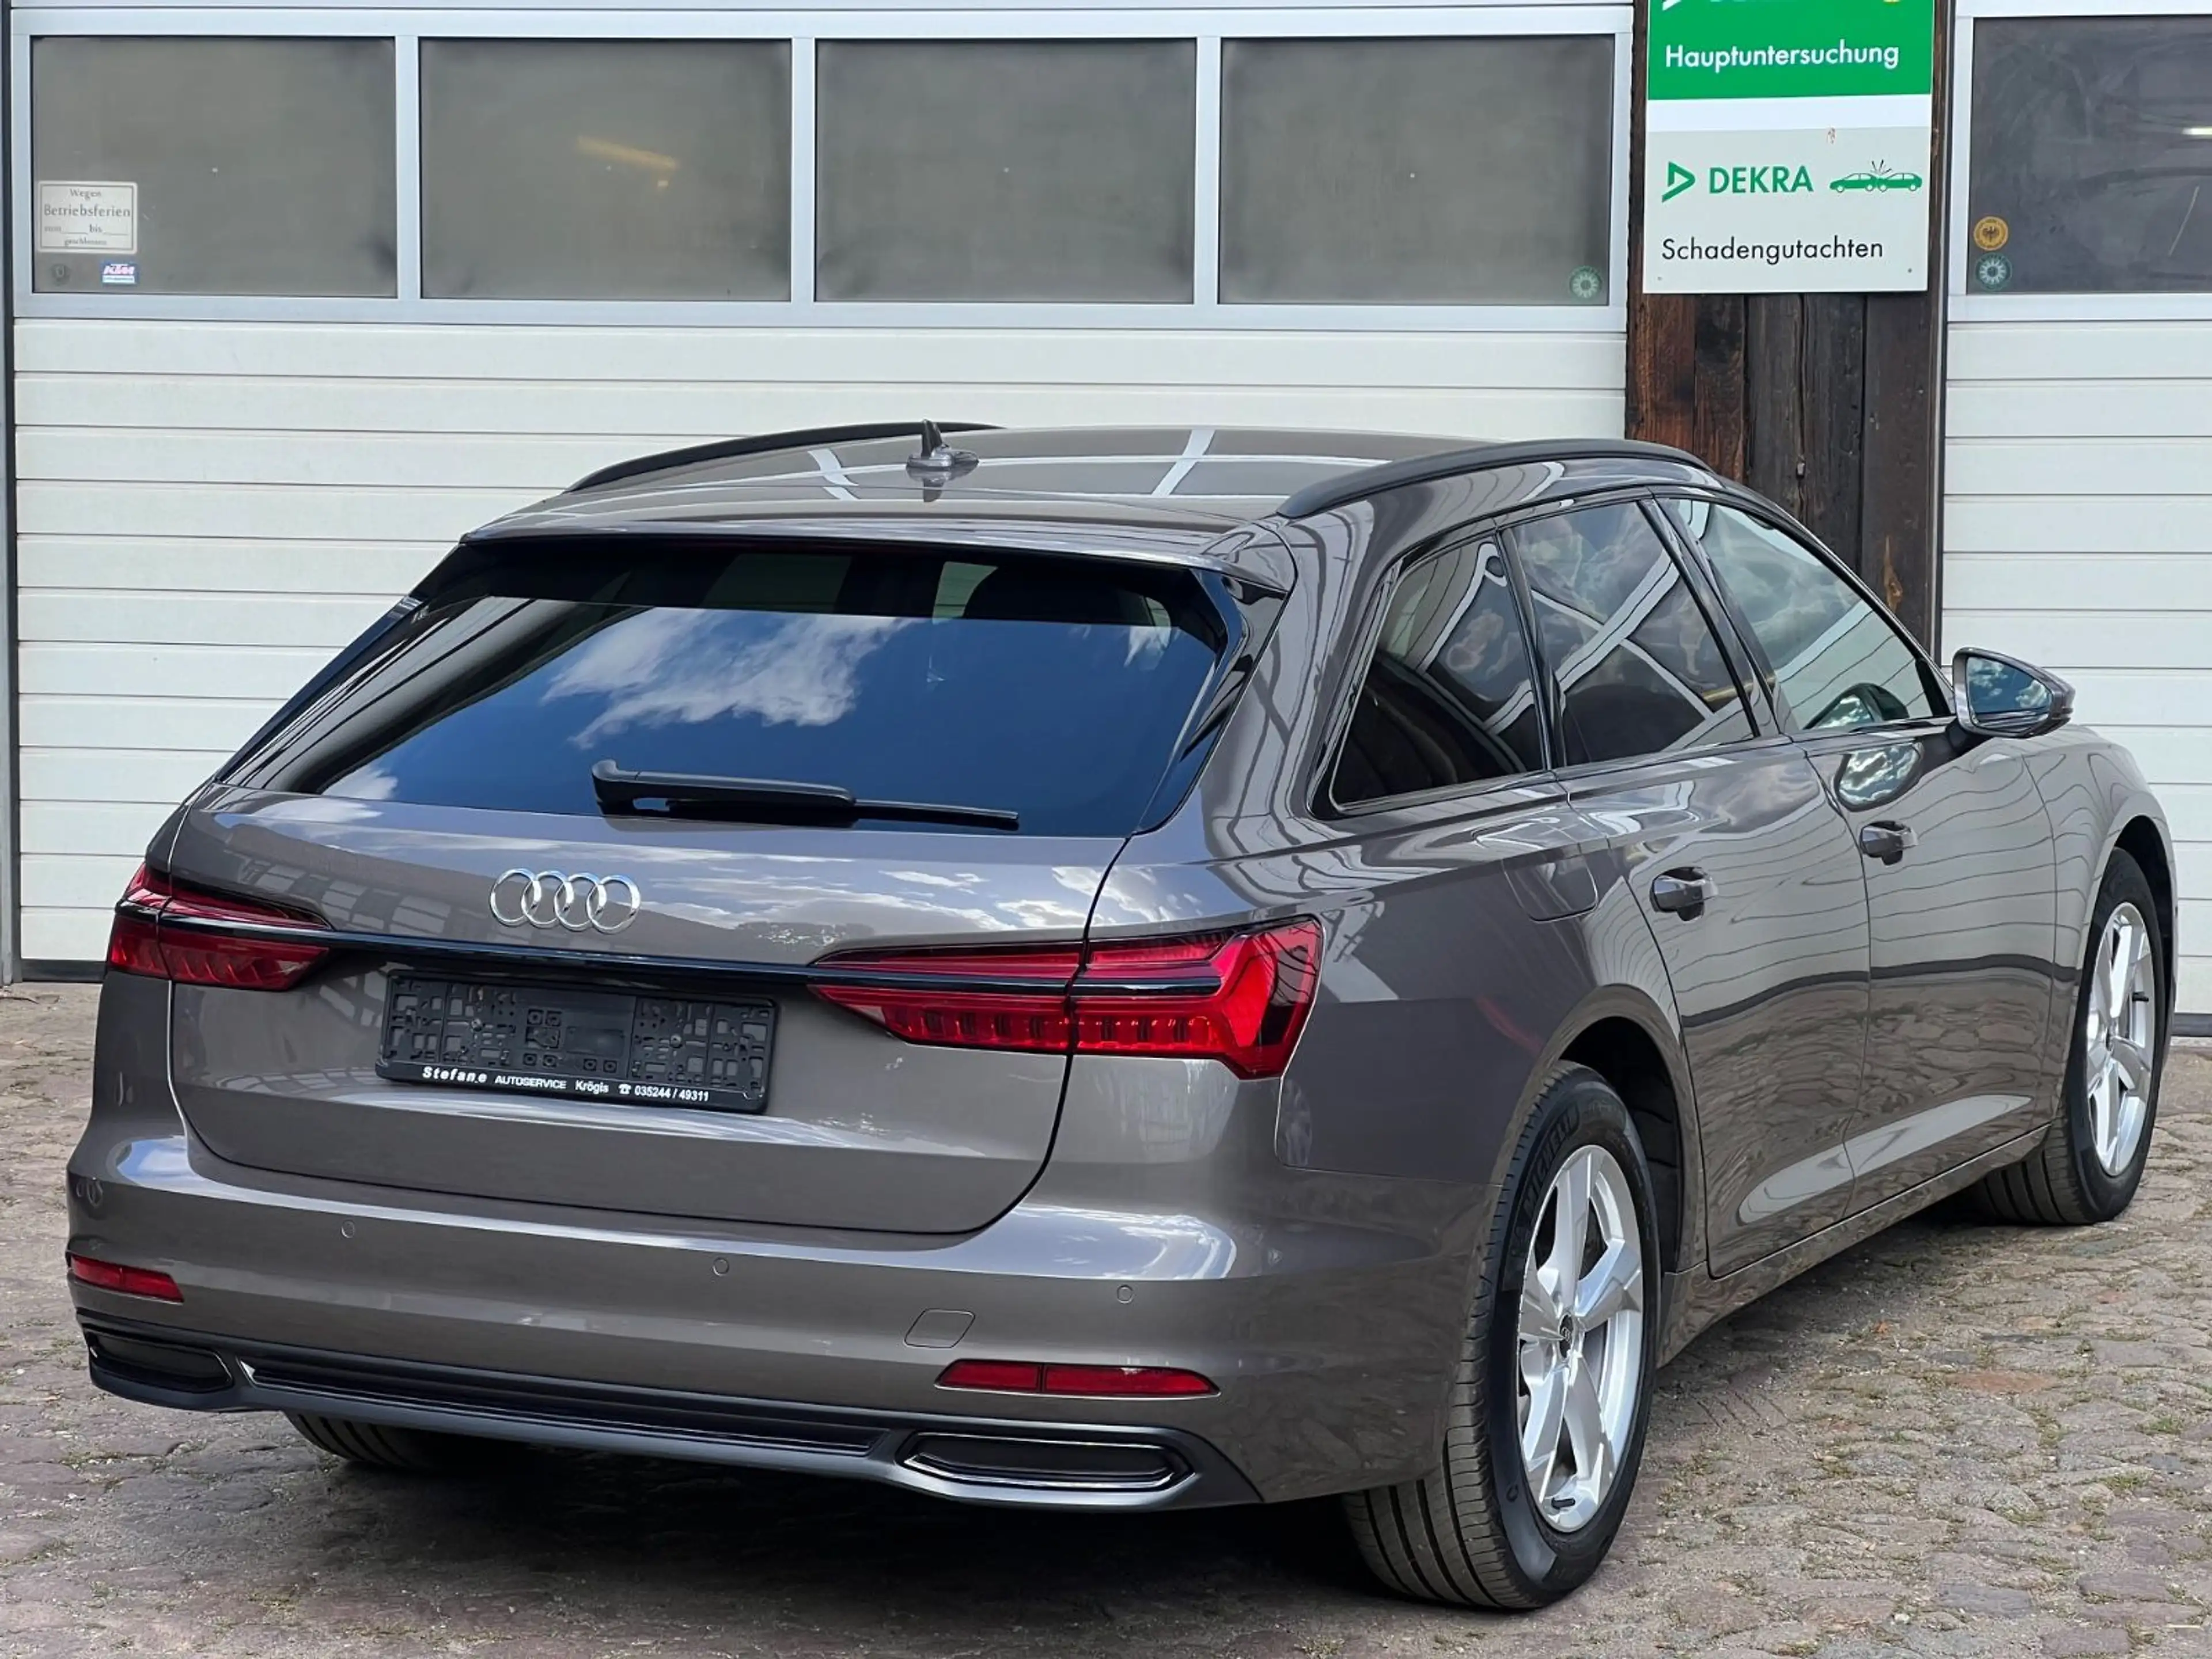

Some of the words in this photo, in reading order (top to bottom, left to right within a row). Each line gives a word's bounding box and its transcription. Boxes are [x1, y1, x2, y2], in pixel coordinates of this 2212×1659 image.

[1665, 39, 1899, 73] Hauptuntersuchung
[1709, 165, 1814, 194] DEKRA
[70, 188, 101, 200] Wegen
[44, 203, 131, 217] Betriebsferien
[89, 224, 103, 233] bis
[65, 237, 107, 247] geschl
[1661, 236, 1884, 266] Schadengutachten
[495, 1075, 566, 1089] AUTOSERVICE
[575, 1080, 609, 1094] Krögis
